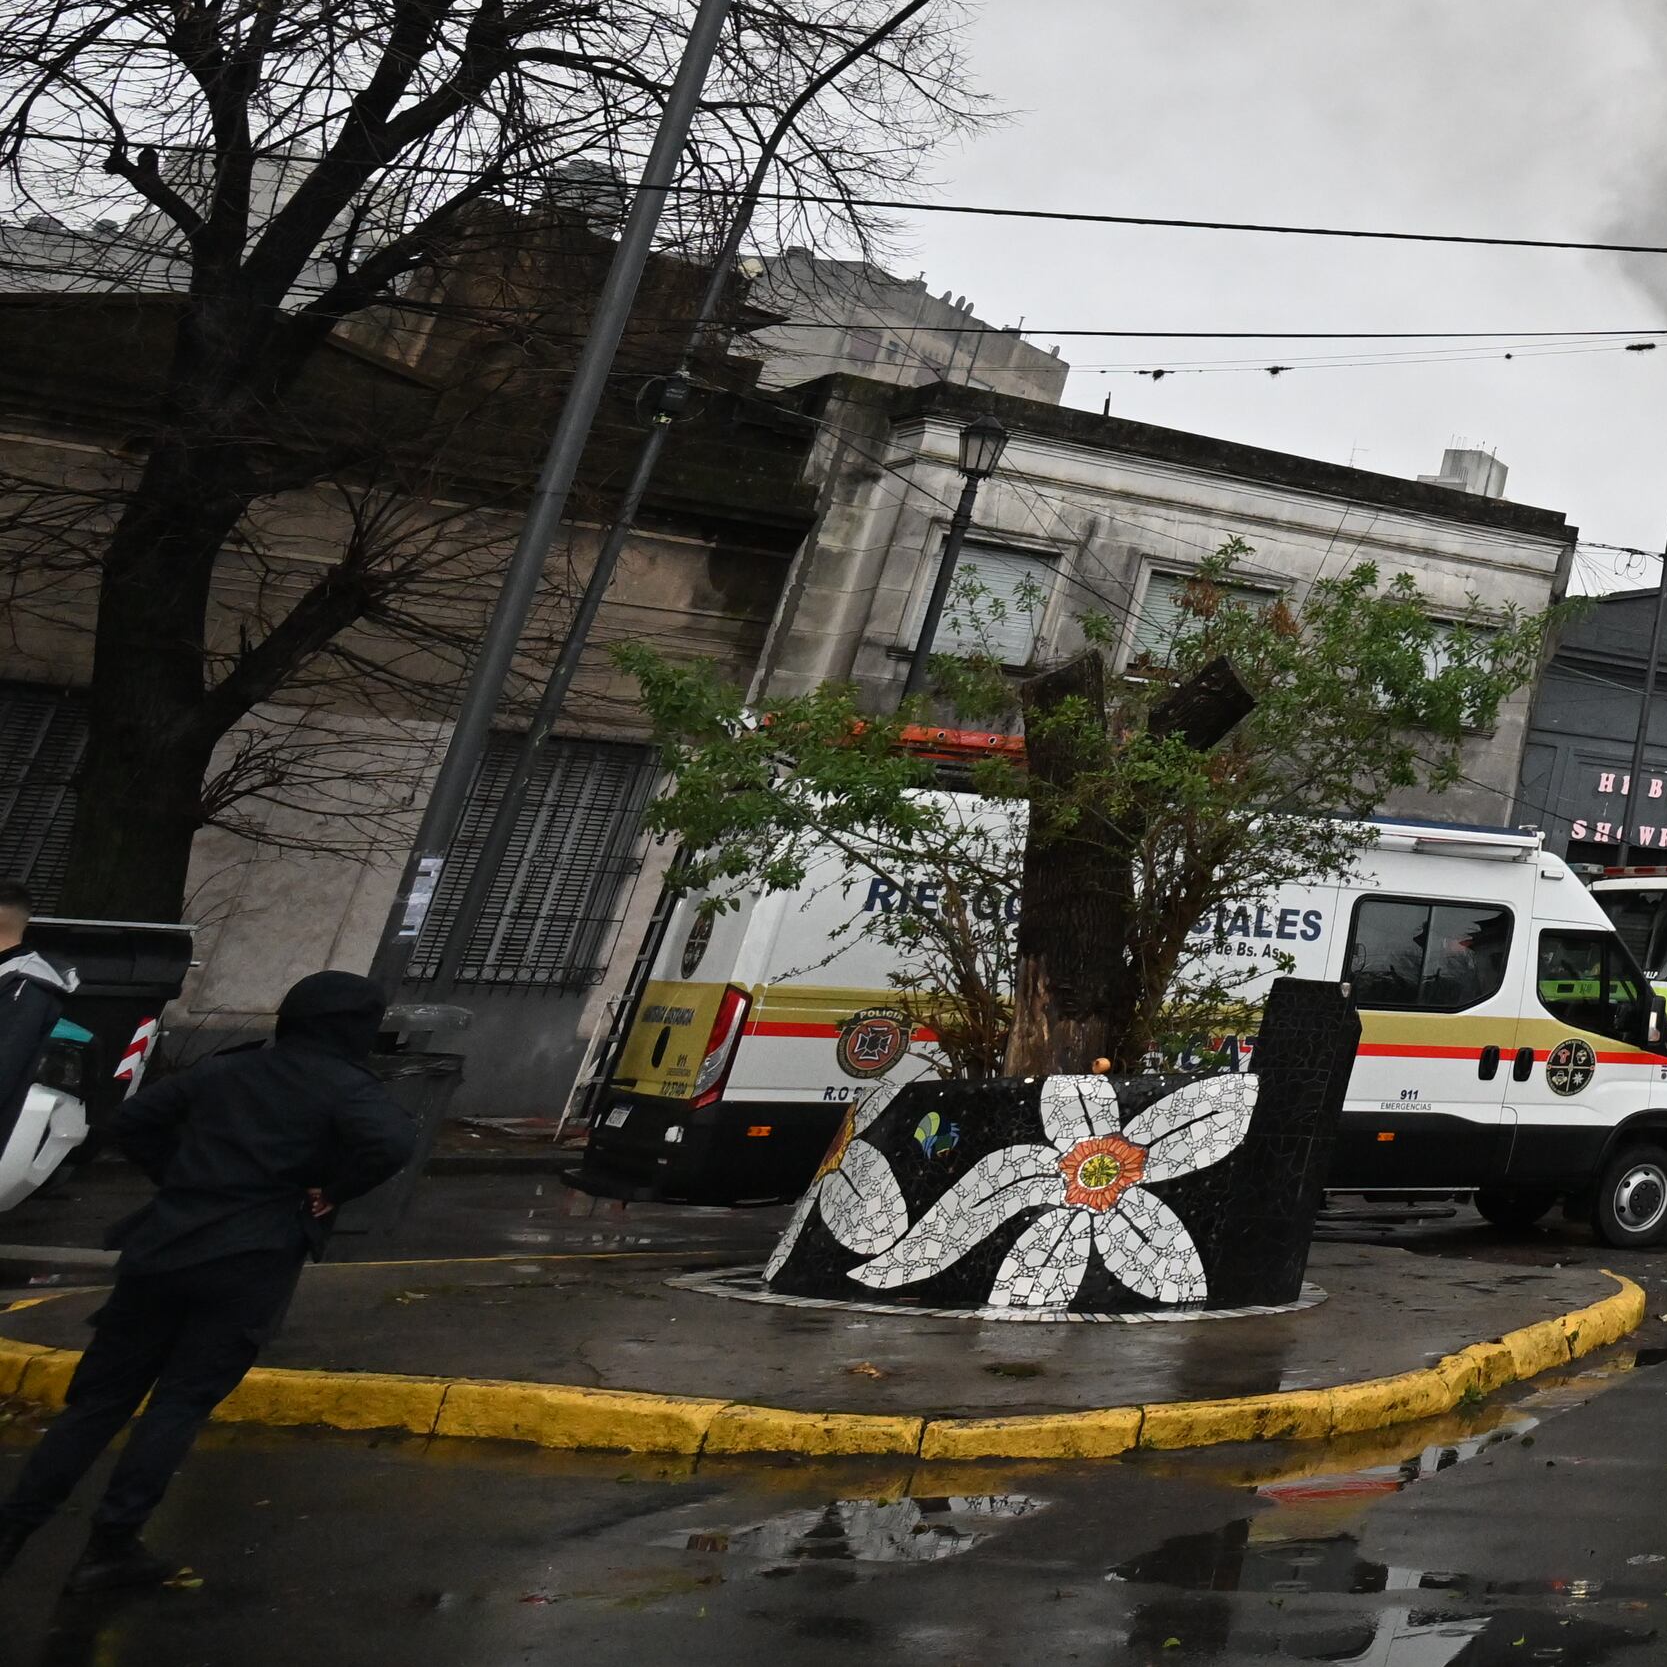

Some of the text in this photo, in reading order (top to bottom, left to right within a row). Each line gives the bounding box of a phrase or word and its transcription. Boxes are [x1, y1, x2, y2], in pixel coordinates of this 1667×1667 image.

[1189, 904, 1323, 942] CIALES
[1237, 942, 1258, 958] Bs.
[860, 1010, 904, 1022] POLICIA
[1400, 1089, 1419, 1100] 911
[1380, 1102, 1432, 1111] EMERGENCIAS
